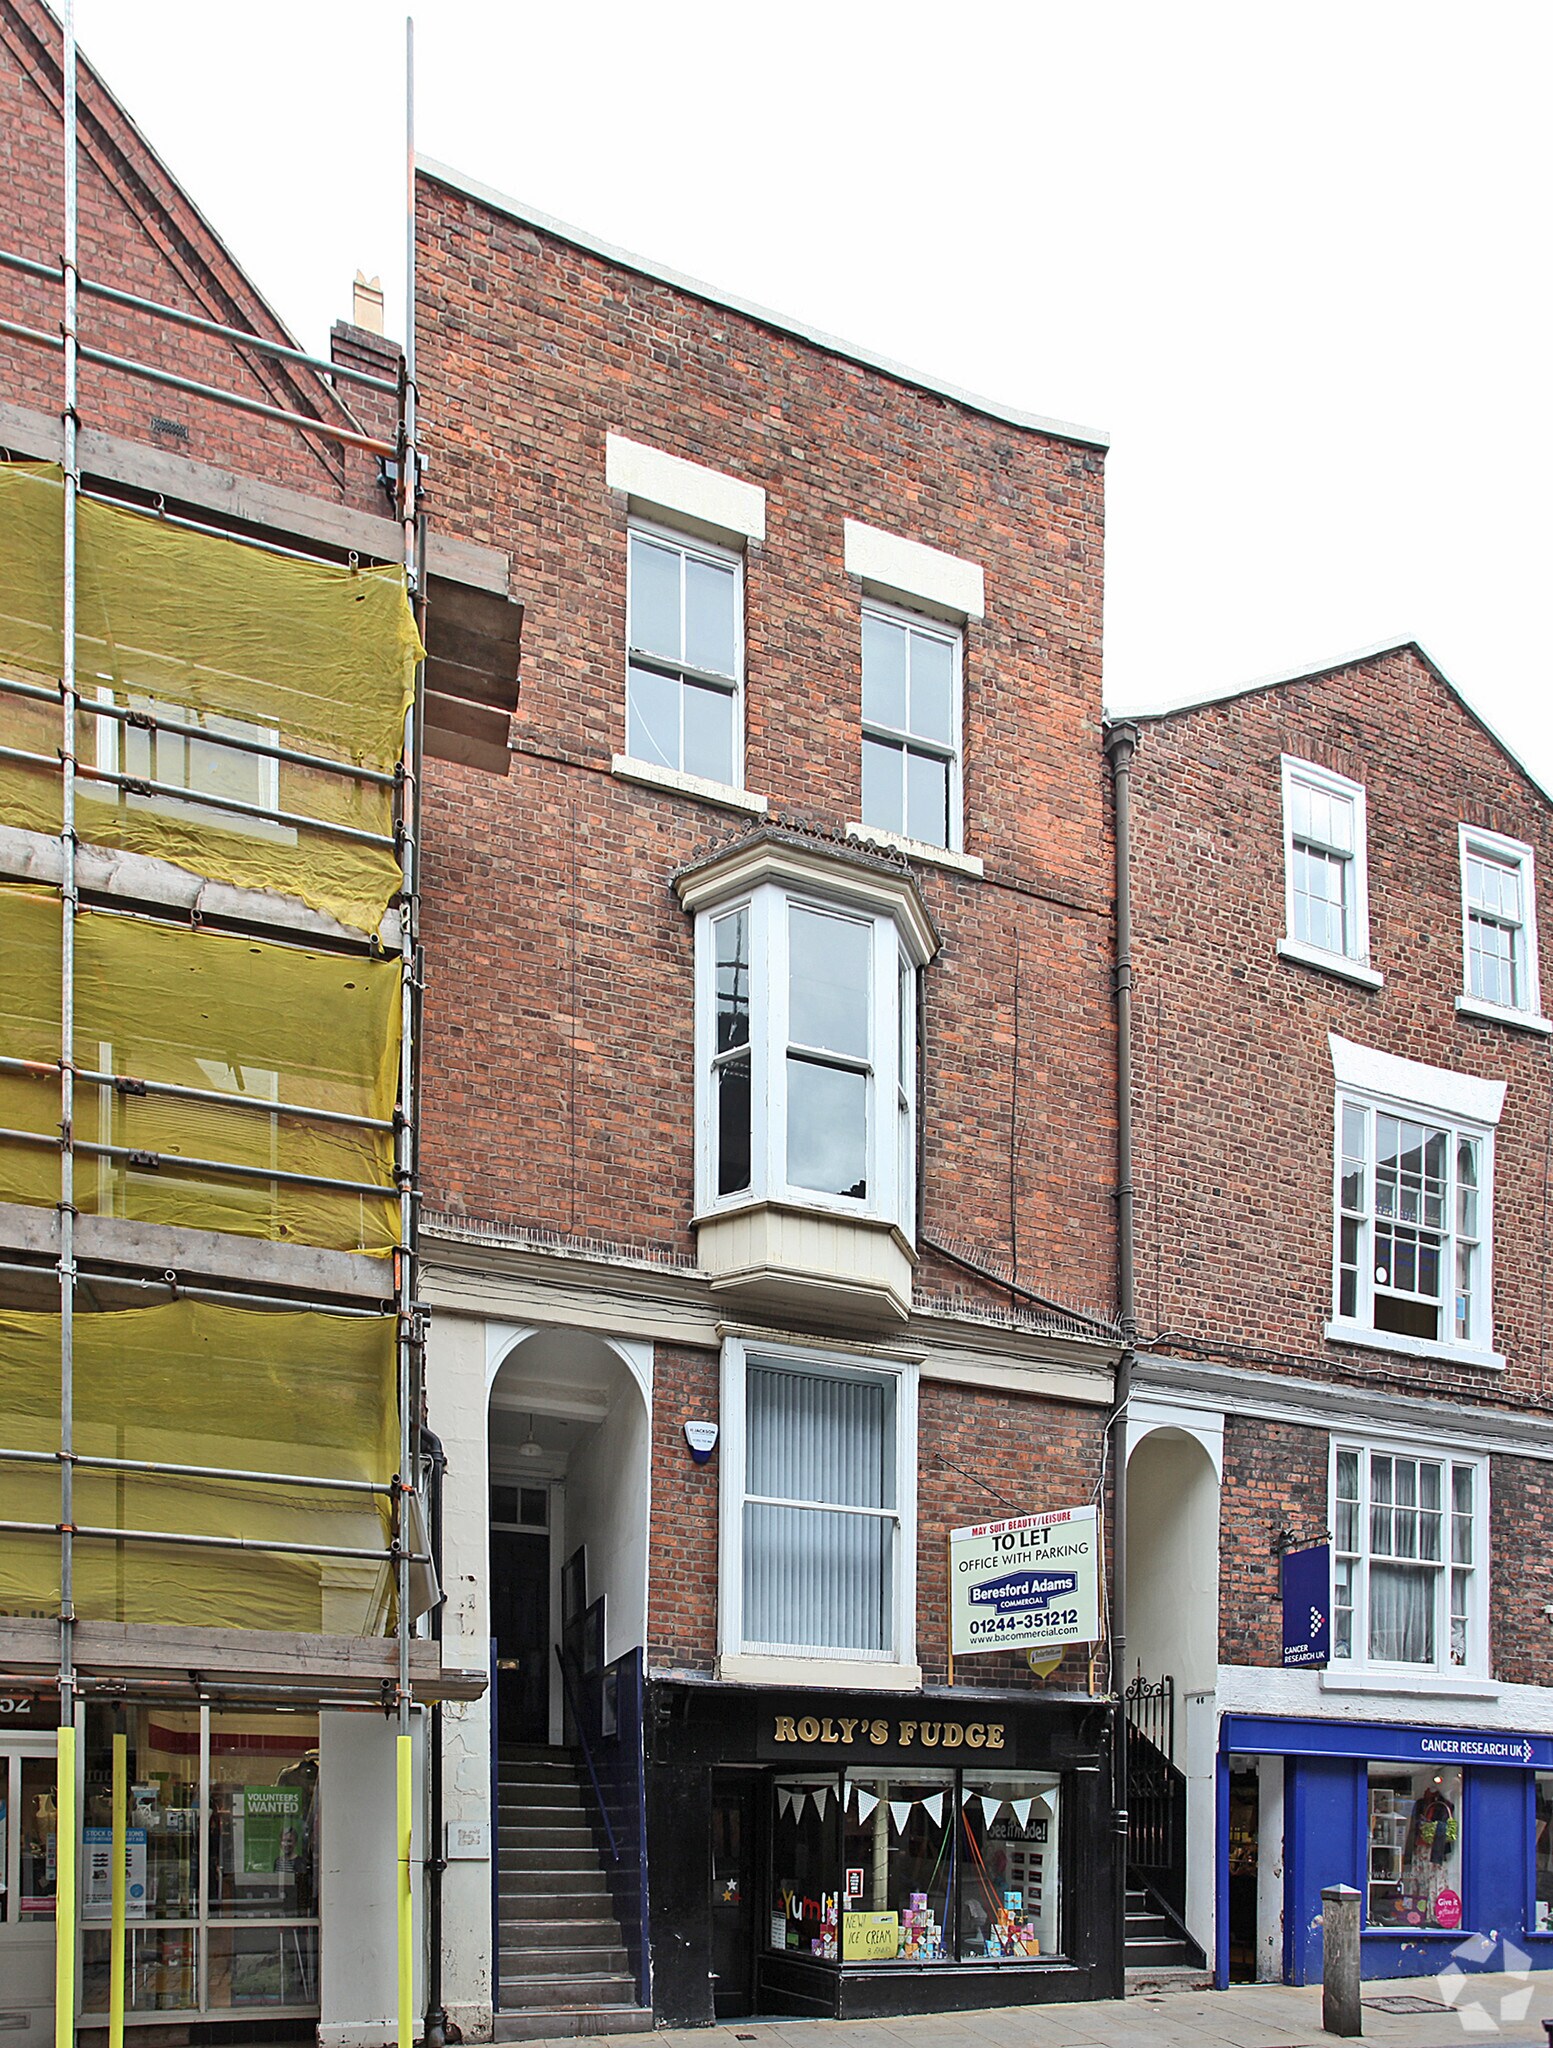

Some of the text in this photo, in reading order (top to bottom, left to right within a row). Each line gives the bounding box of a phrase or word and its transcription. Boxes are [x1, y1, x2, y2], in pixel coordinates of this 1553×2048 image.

[972, 1511, 1071, 1536] MAY SUIT BEAUTY/LEISURE
[992, 1528, 1051, 1552] TO LET
[958, 1542, 1088, 1572] OFFICE WITH PARKING
[972, 1576, 1072, 1602] Beresford Adams
[1000, 1596, 1044, 1608] COMMERCIAL
[970, 1609, 1078, 1634] 01244-351212
[970, 1625, 1078, 1644] www.bacommercial.com
[1284, 1644, 1308, 1654] CANCER
[1284, 1650, 1325, 1663] RESEARCH UK
[774, 1716, 1004, 1748] ROLY'S FUDGE
[1422, 1739, 1522, 1757] CANCER RESEARCH UK
[248, 1794, 298, 1802] VOLUNTEERS
[248, 1802, 299, 1813] WANTED
[782, 1888, 826, 1923] Yum!
[1438, 1898, 1452, 1906] Give
[848, 1930, 892, 1945] ICE CREAM
